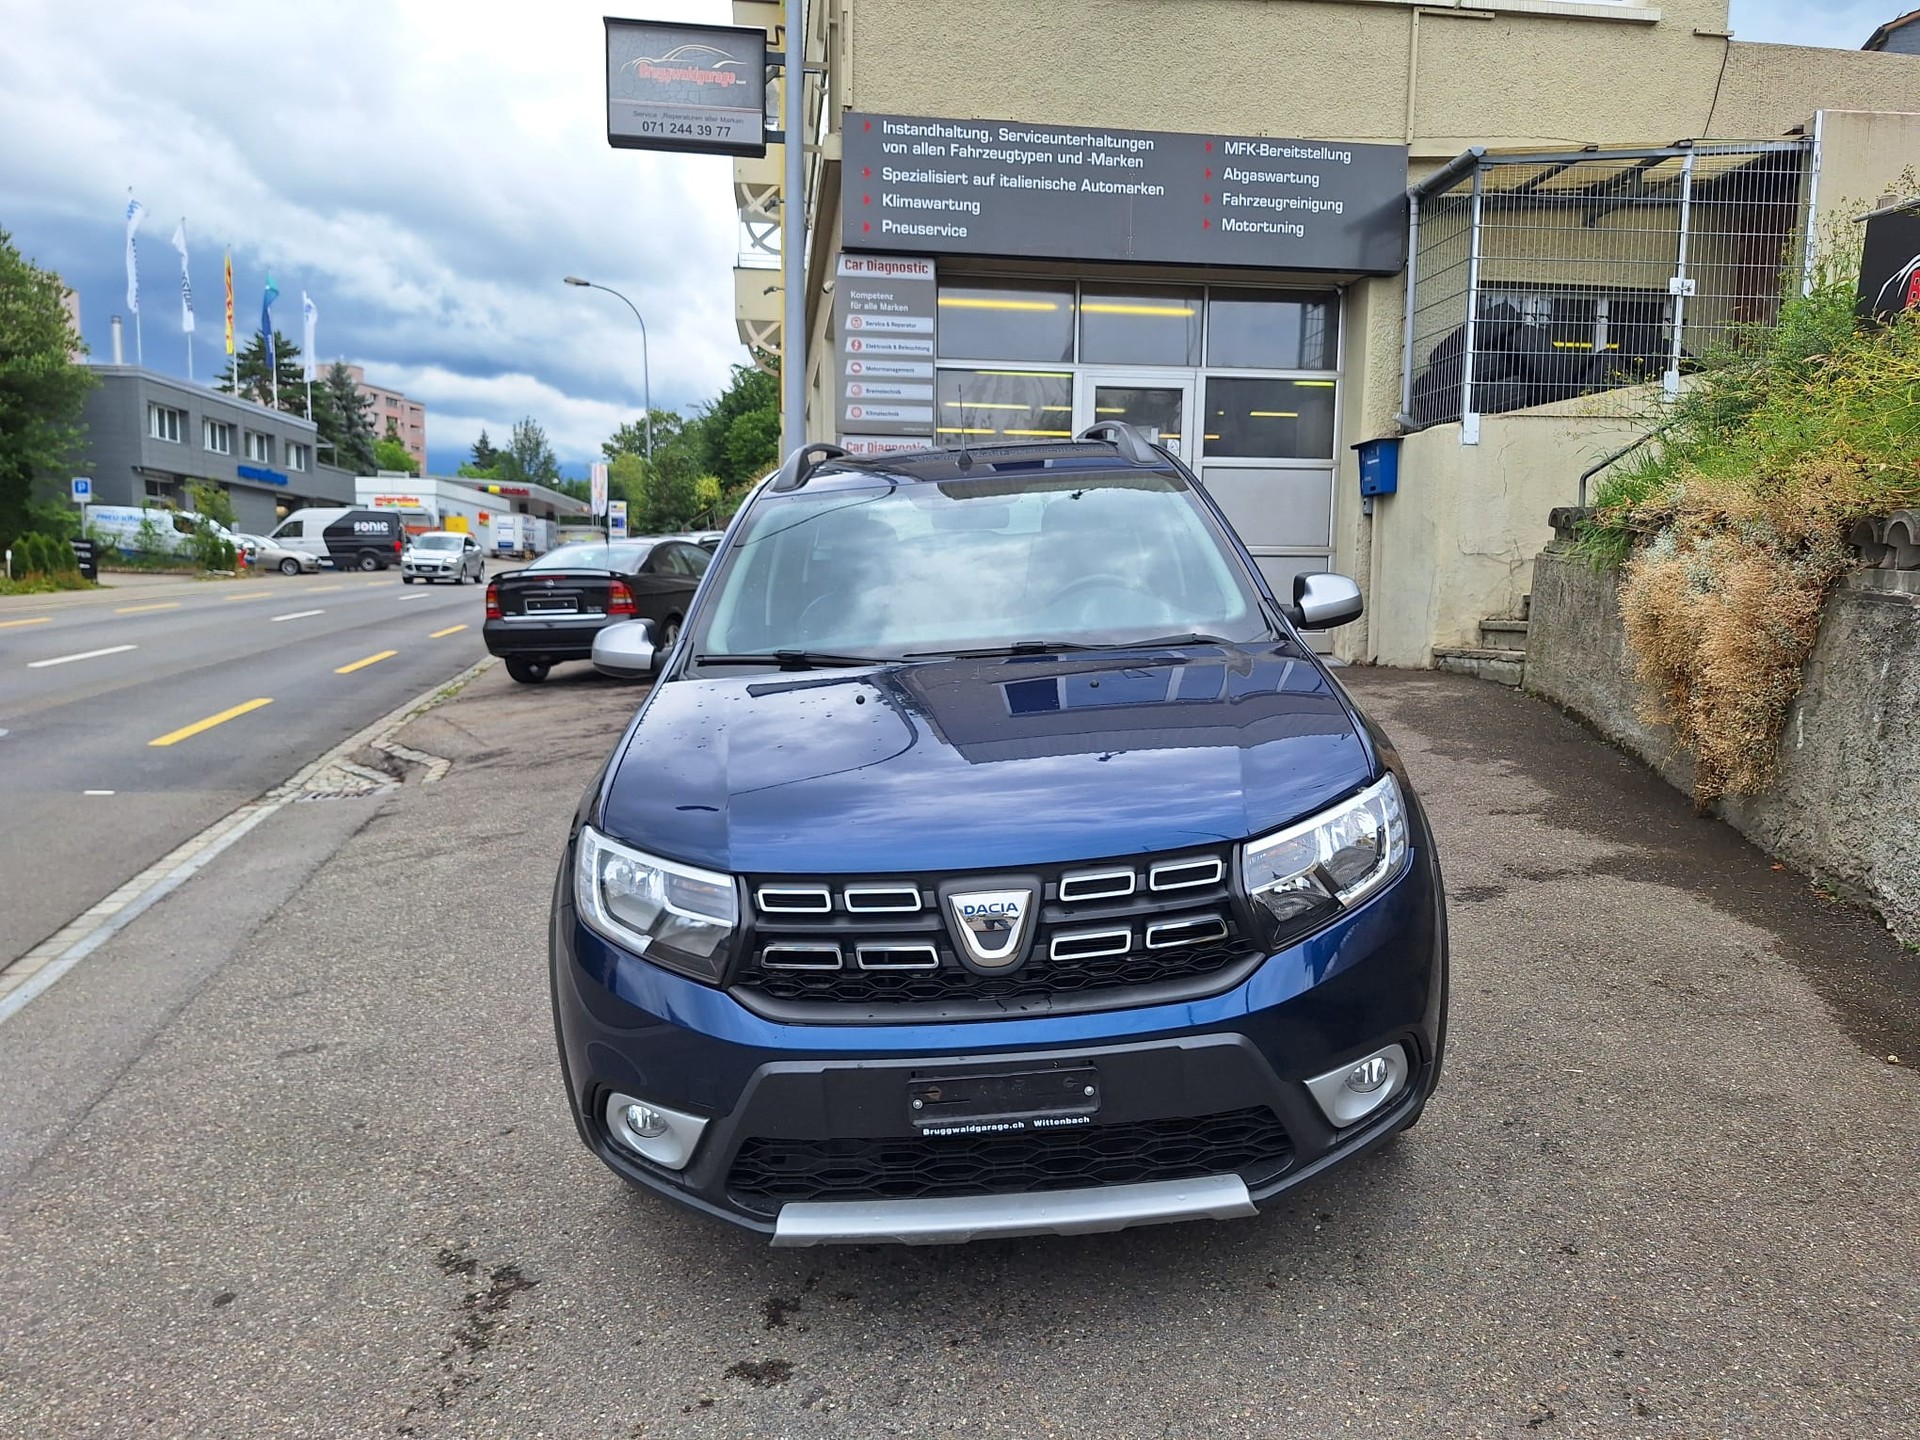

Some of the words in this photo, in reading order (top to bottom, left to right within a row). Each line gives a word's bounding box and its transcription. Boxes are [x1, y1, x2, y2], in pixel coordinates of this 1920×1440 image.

[638, 62, 736, 88] Bruggwaldgarage
[642, 120, 664, 133] 071
[670, 123, 692, 135] 244
[697, 124, 712, 136] 39
[716, 126, 731, 137] 77
[882, 121, 993, 142] Instandhaltung,
[998, 128, 1155, 152] Serviceunterhaltungen
[882, 143, 907, 154] von
[912, 142, 946, 156] allen
[950, 144, 1052, 164] Fahrzeugtypen
[1057, 152, 1083, 165] und
[1086, 154, 1143, 168] -Marken
[1224, 141, 1352, 164] MFK-Bereitstellung
[882, 167, 969, 186] Spezialisiert
[973, 173, 995, 186] auf
[999, 174, 1077, 192] italienische
[1080, 180, 1165, 196] Automarken
[1223, 167, 1320, 188] Abgaswartung
[882, 194, 981, 215] Klimawartung
[1222, 193, 1344, 214] Fahrzeugreinigung
[882, 220, 968, 238] Pneuservice
[1221, 218, 1305, 238] Motortuning
[844, 259, 864, 271] Car
[867, 260, 929, 275] Diagnostic
[850, 291, 894, 301] Kompetenz
[850, 301, 862, 310] für
[864, 302, 878, 311] alle
[880, 303, 909, 312] Marken
[846, 441, 865, 453] Car
[77, 481, 87, 493] P
[963, 902, 1019, 916] DACIA
[922, 1120, 1025, 1136] Bruggwaldgarage.ch
[1033, 1115, 1090, 1128] Wittenbach
